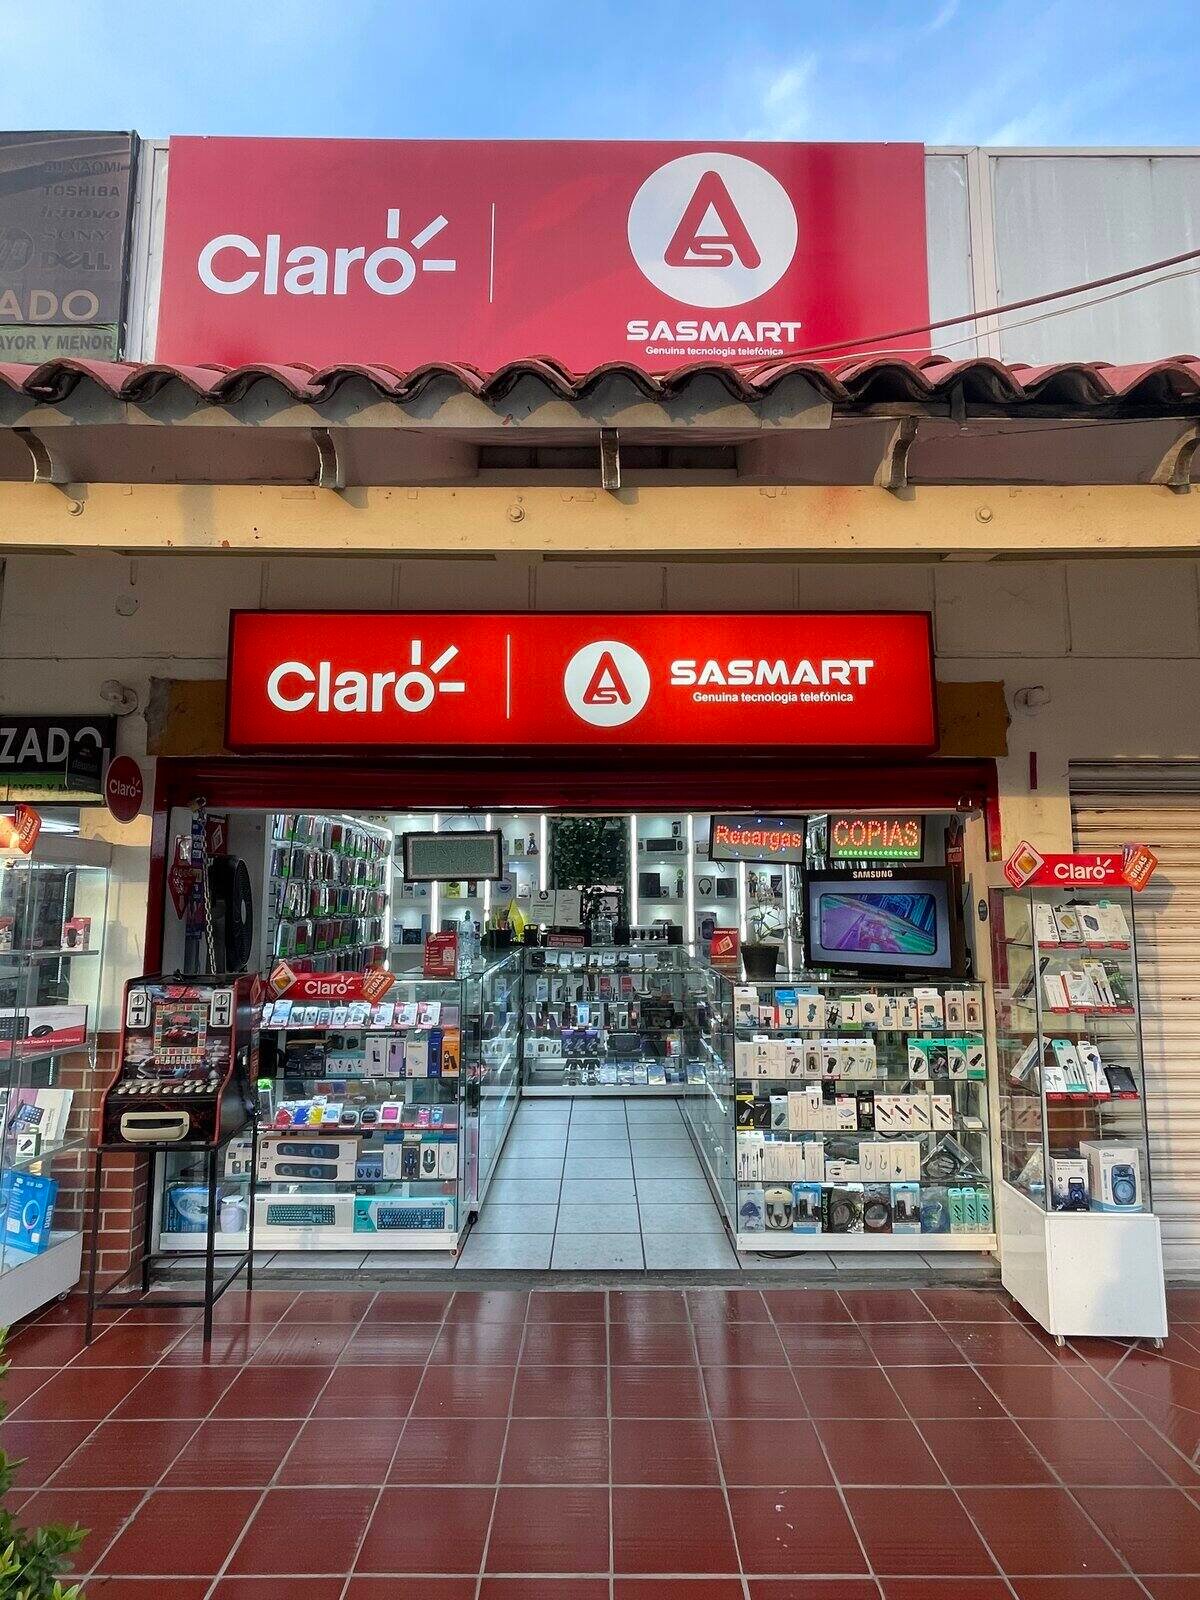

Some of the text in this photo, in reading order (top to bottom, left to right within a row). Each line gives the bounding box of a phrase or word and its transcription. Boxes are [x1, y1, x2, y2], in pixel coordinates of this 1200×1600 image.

[43, 186, 120, 197] TOSHIBA
[198, 234, 417, 297] Claro
[0, 289, 100, 321] ADO
[626, 320, 802, 343] SASMART
[42, 335, 52, 350] Y
[57, 335, 112, 350] MENOR
[645, 346, 685, 356] Genuina
[738, 346, 784, 357] telefónica
[670, 659, 874, 686] SASMART
[267, 661, 435, 713] Claro
[693, 692, 738, 702] Genuina
[800, 691, 854, 702] telefónica
[109, 778, 136, 798] Claro
[715, 825, 802, 851] Recargas
[833, 820, 919, 847] COPIAS
[852, 870, 893, 879] SAMSUNG
[1054, 863, 1106, 879] Claro
[1130, 856, 1148, 879] GIGAS
[304, 980, 348, 996] Claro
[367, 973, 385, 994] GIGAS
